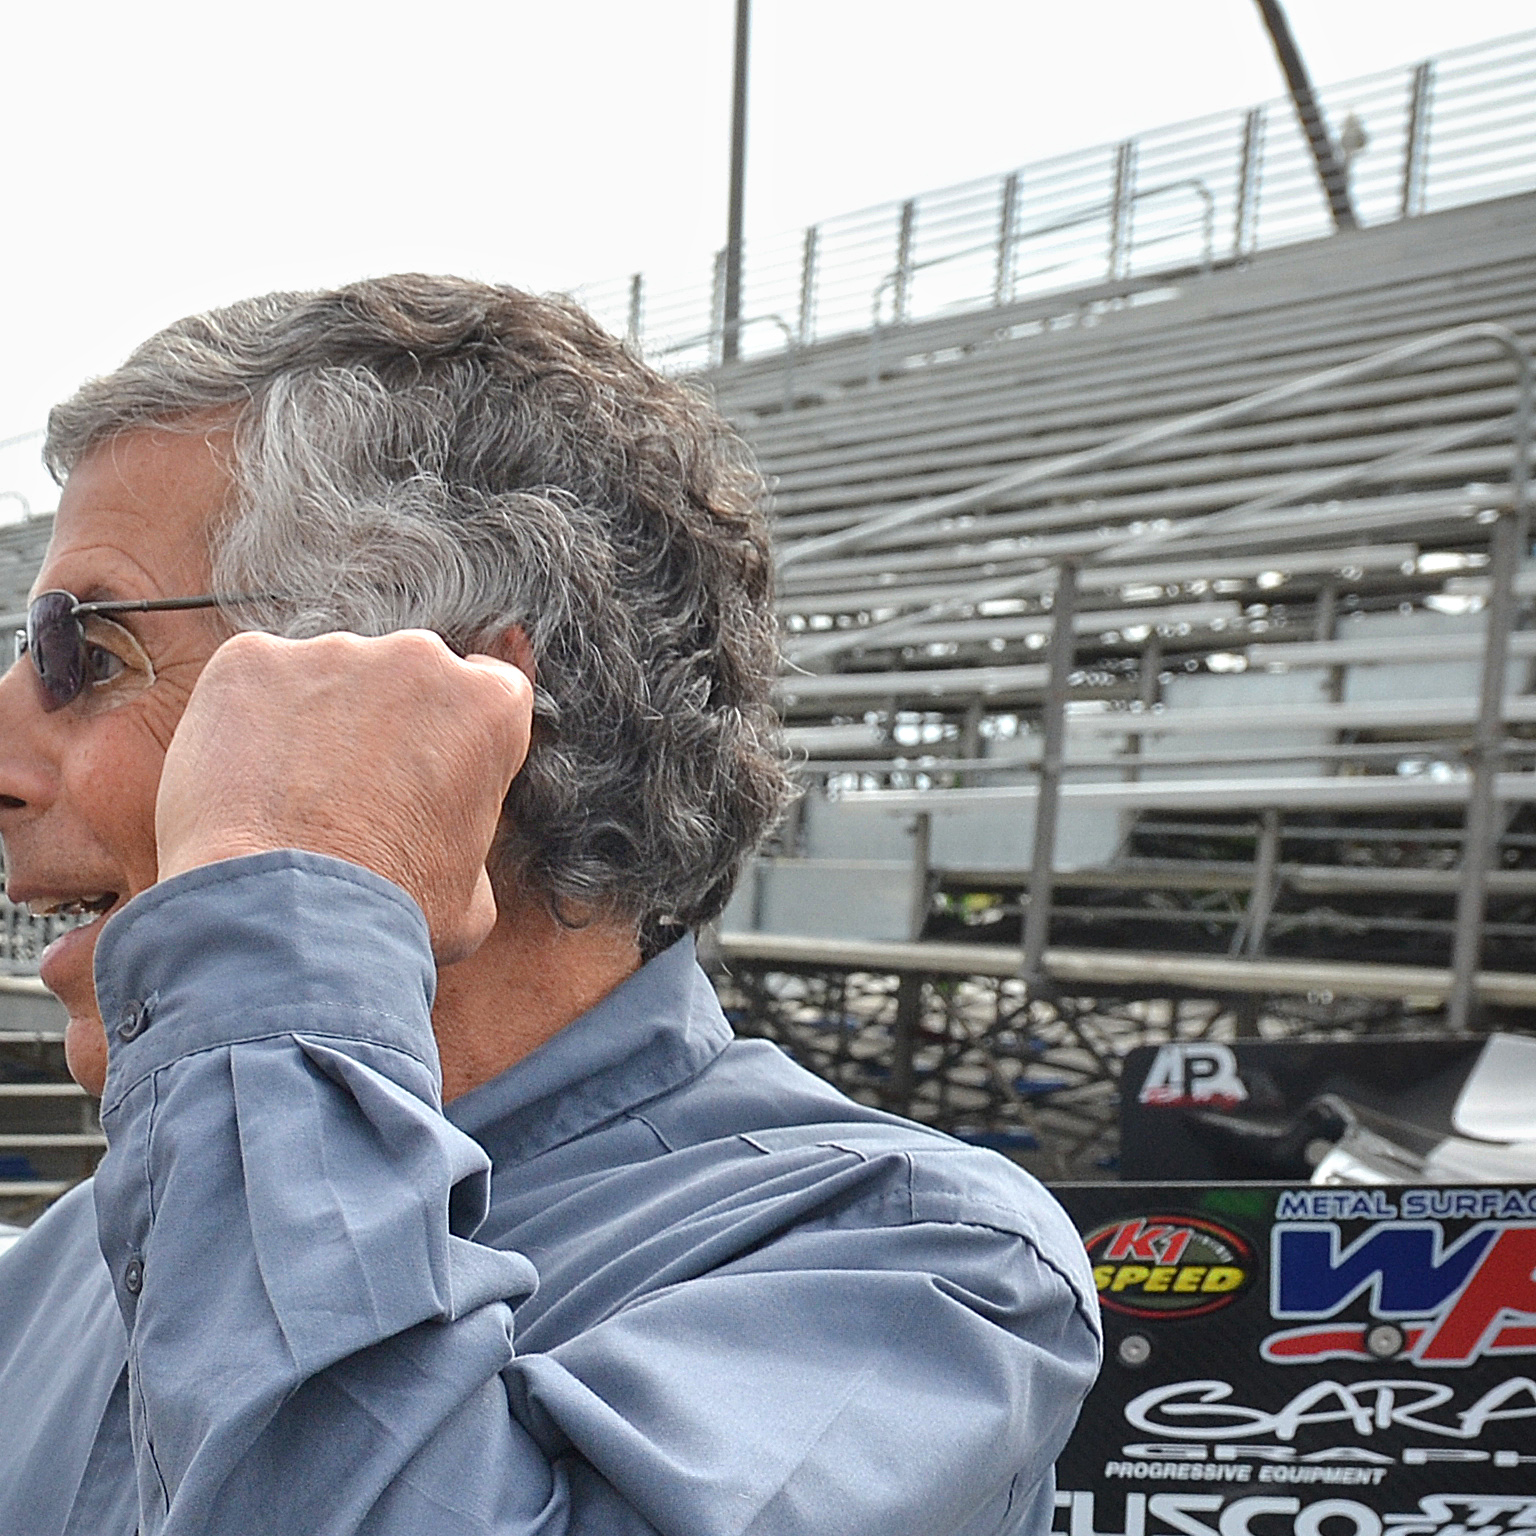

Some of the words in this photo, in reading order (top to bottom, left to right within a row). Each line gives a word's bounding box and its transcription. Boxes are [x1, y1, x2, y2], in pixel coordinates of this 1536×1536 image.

[1275, 1189, 1399, 1220] METAL
[1103, 1217, 1194, 1266] K1
[1093, 1264, 1246, 1293] SPEED
[1104, 1461, 1253, 1483] PROGRESSIVE
[1257, 1464, 1387, 1486] EQUIPMENT
